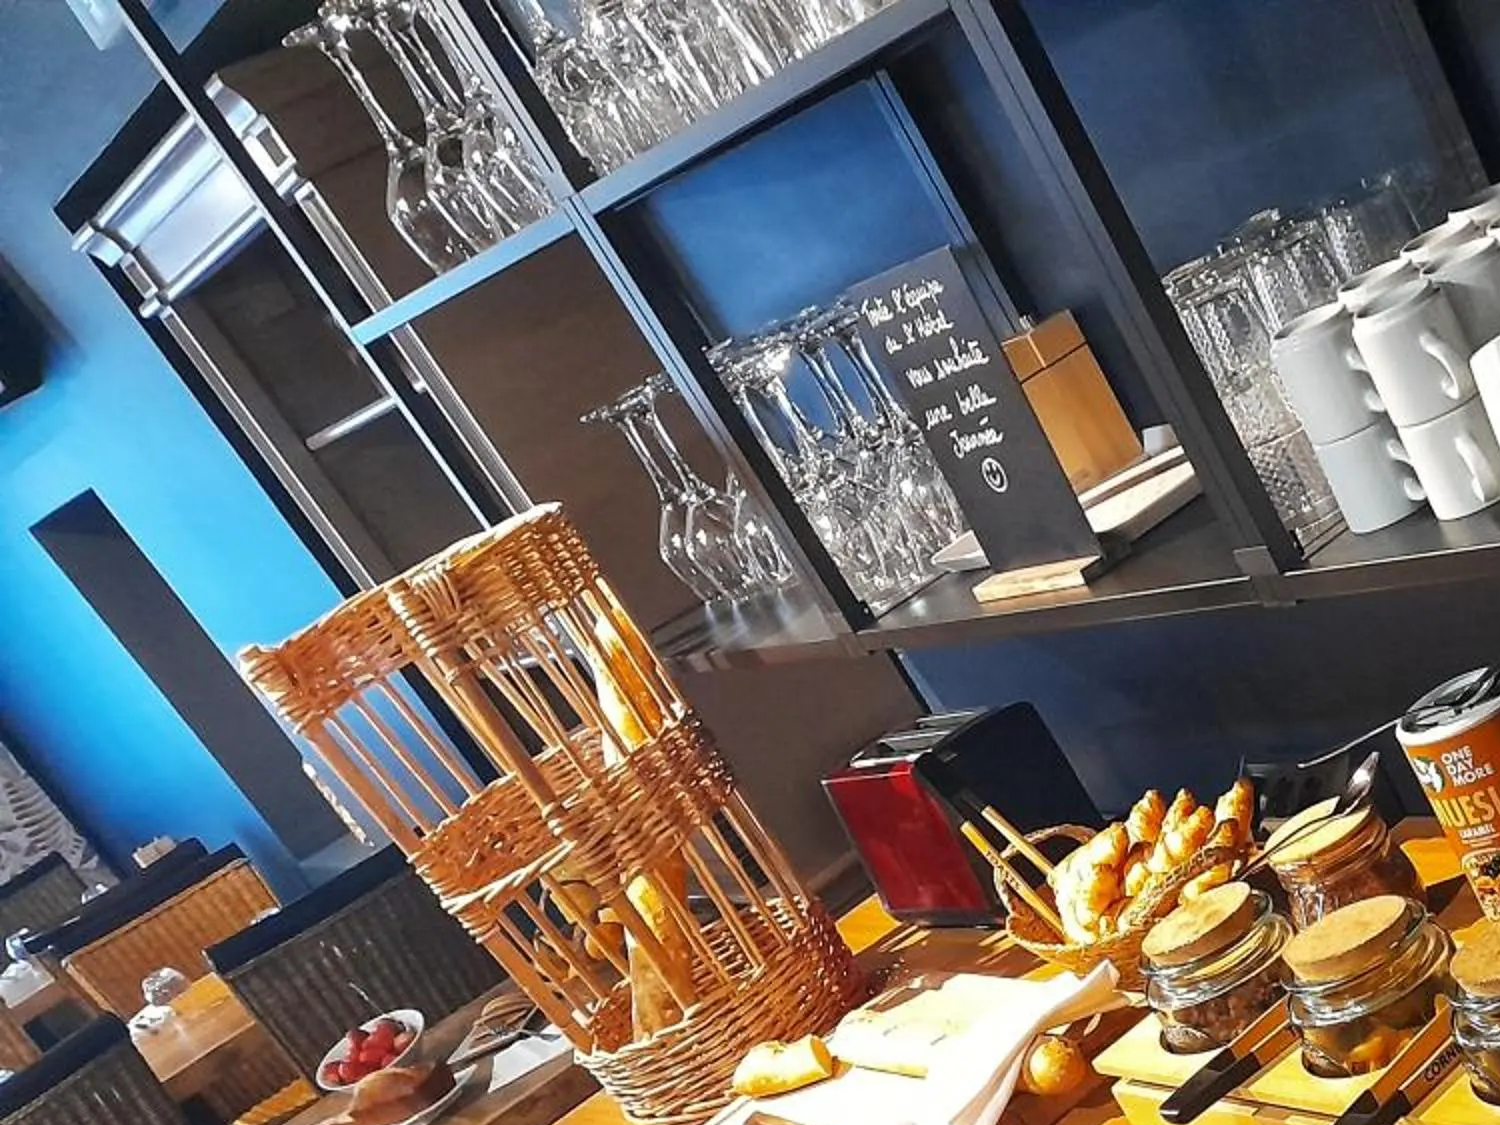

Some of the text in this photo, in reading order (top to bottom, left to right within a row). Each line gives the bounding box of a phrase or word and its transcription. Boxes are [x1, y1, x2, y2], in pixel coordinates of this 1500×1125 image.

[1441, 745, 1473, 766] ONE
[1445, 758, 1475, 777] DAY
[1452, 762, 1495, 788] MORE
